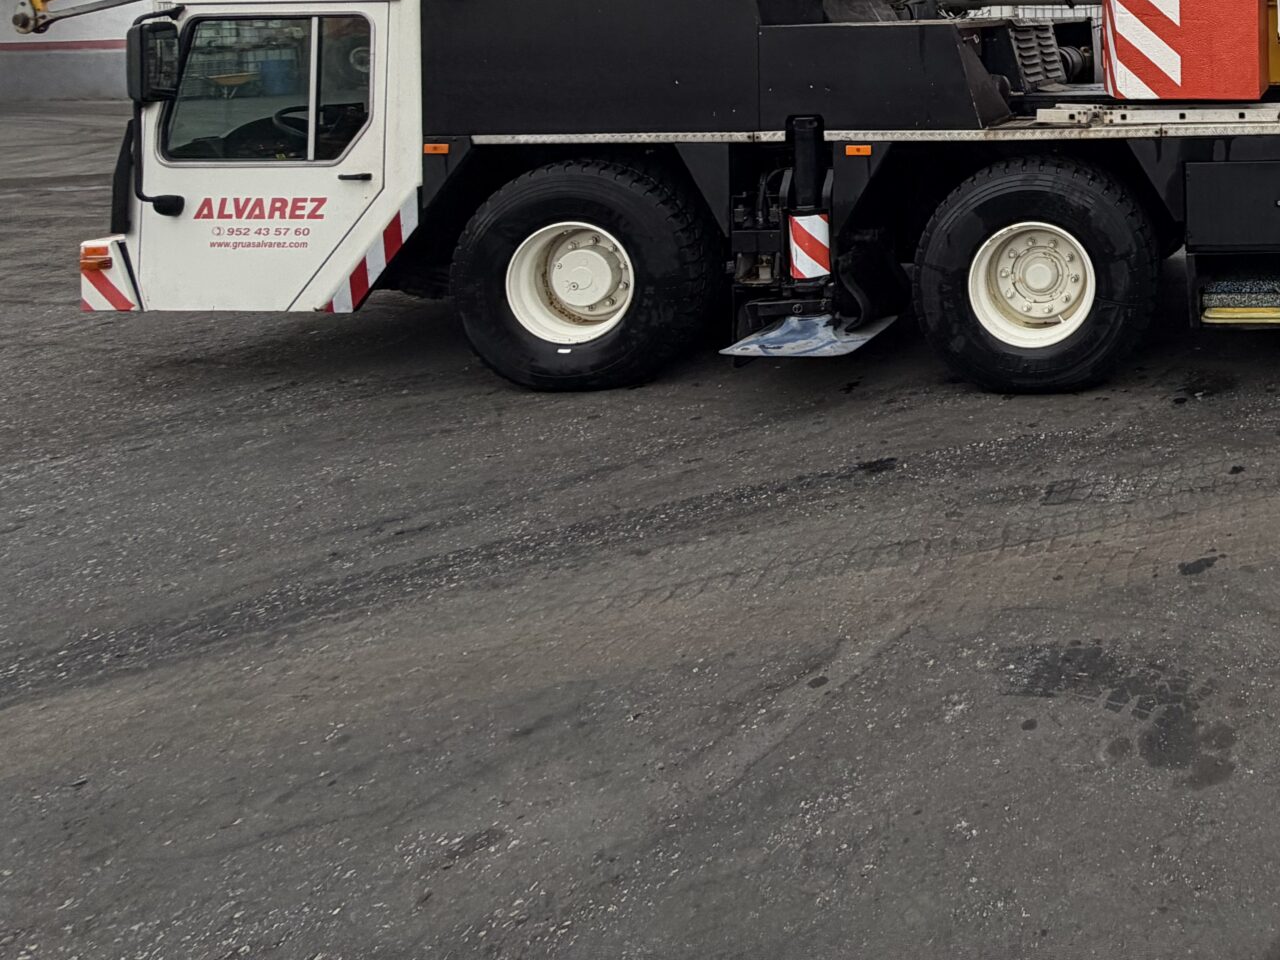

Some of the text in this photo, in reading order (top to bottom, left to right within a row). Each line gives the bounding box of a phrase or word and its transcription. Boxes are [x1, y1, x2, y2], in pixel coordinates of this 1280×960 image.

[193, 197, 327, 219] ALVAREZ
[226, 227, 310, 236] 952 43 57 60
[209, 240, 308, 249] www.gruasalvarez.com
